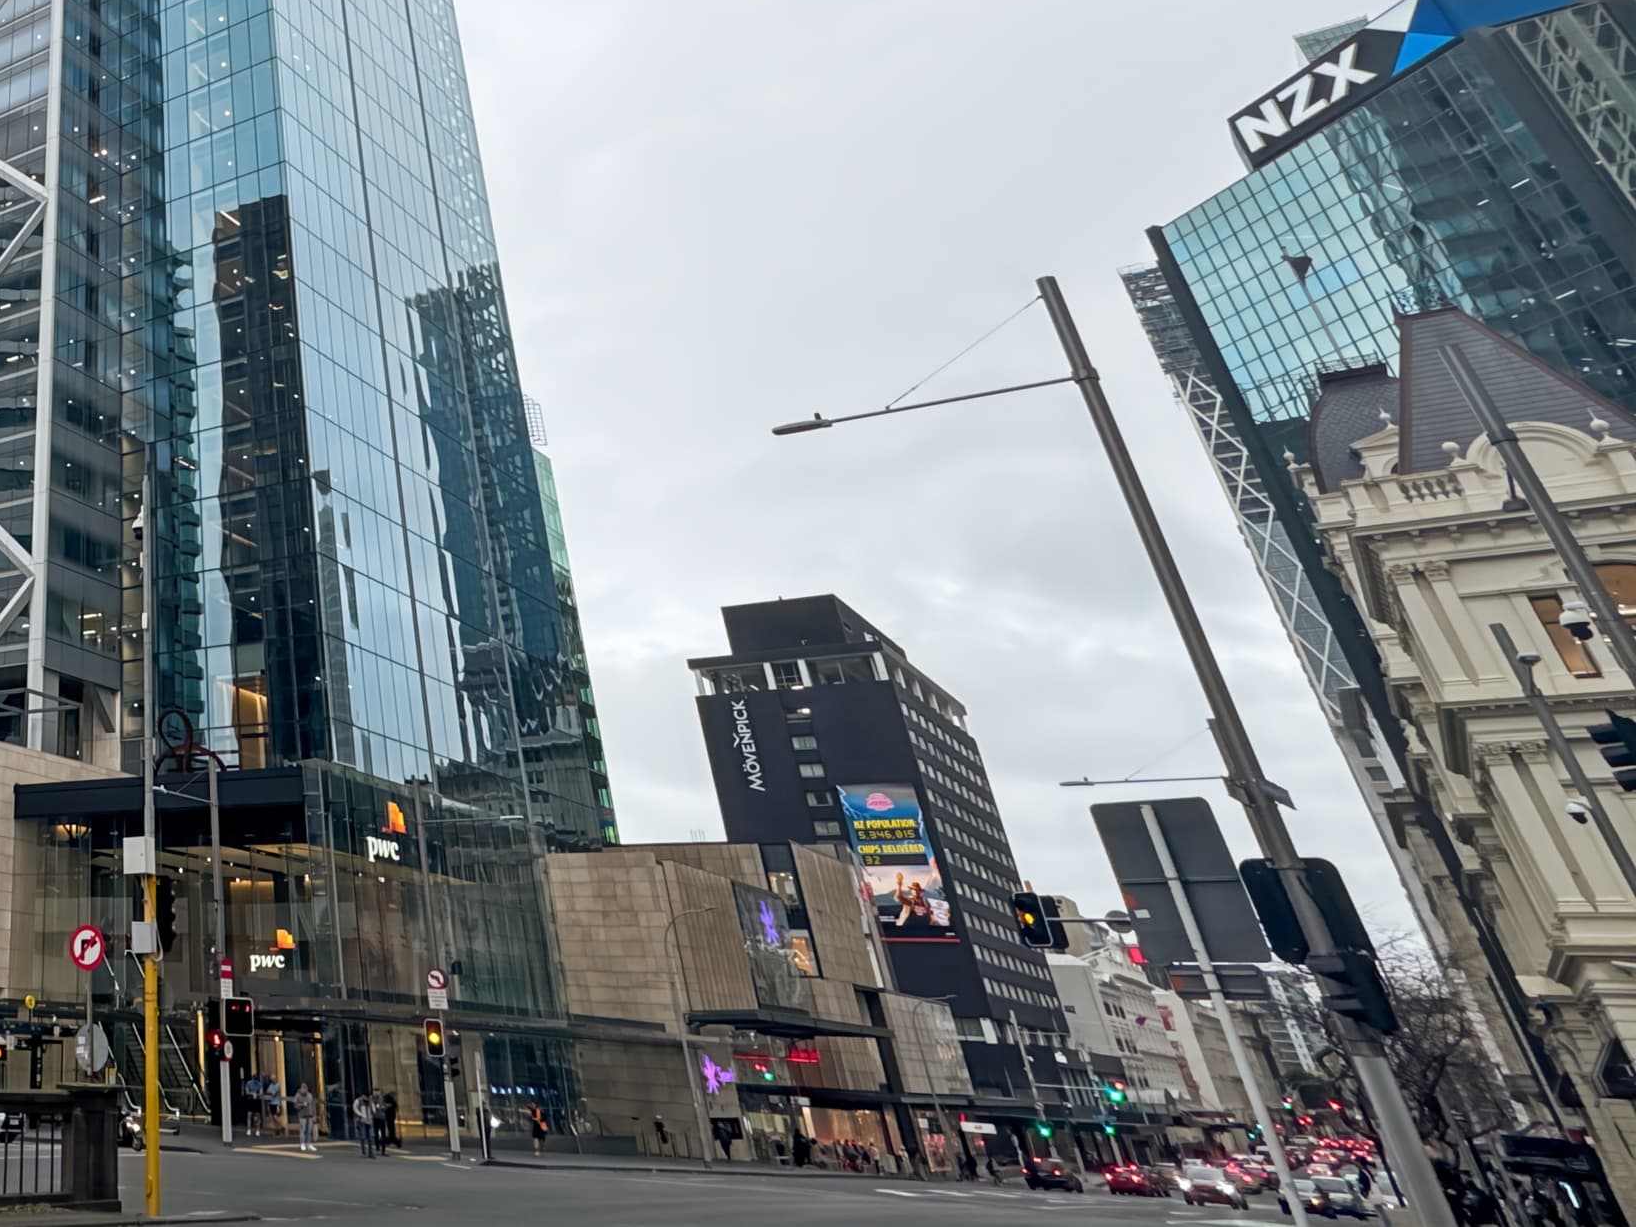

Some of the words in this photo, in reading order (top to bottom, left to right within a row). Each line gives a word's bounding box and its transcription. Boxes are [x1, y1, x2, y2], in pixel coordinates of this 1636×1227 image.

[1234, 42, 1378, 153] NZX
[365, 835, 400, 863] pwc
[857, 844, 881, 854] CHIPS
[882, 844, 926, 853] DELIVERED
[865, 855, 881, 865] 32
[249, 954, 286, 972] pwc
